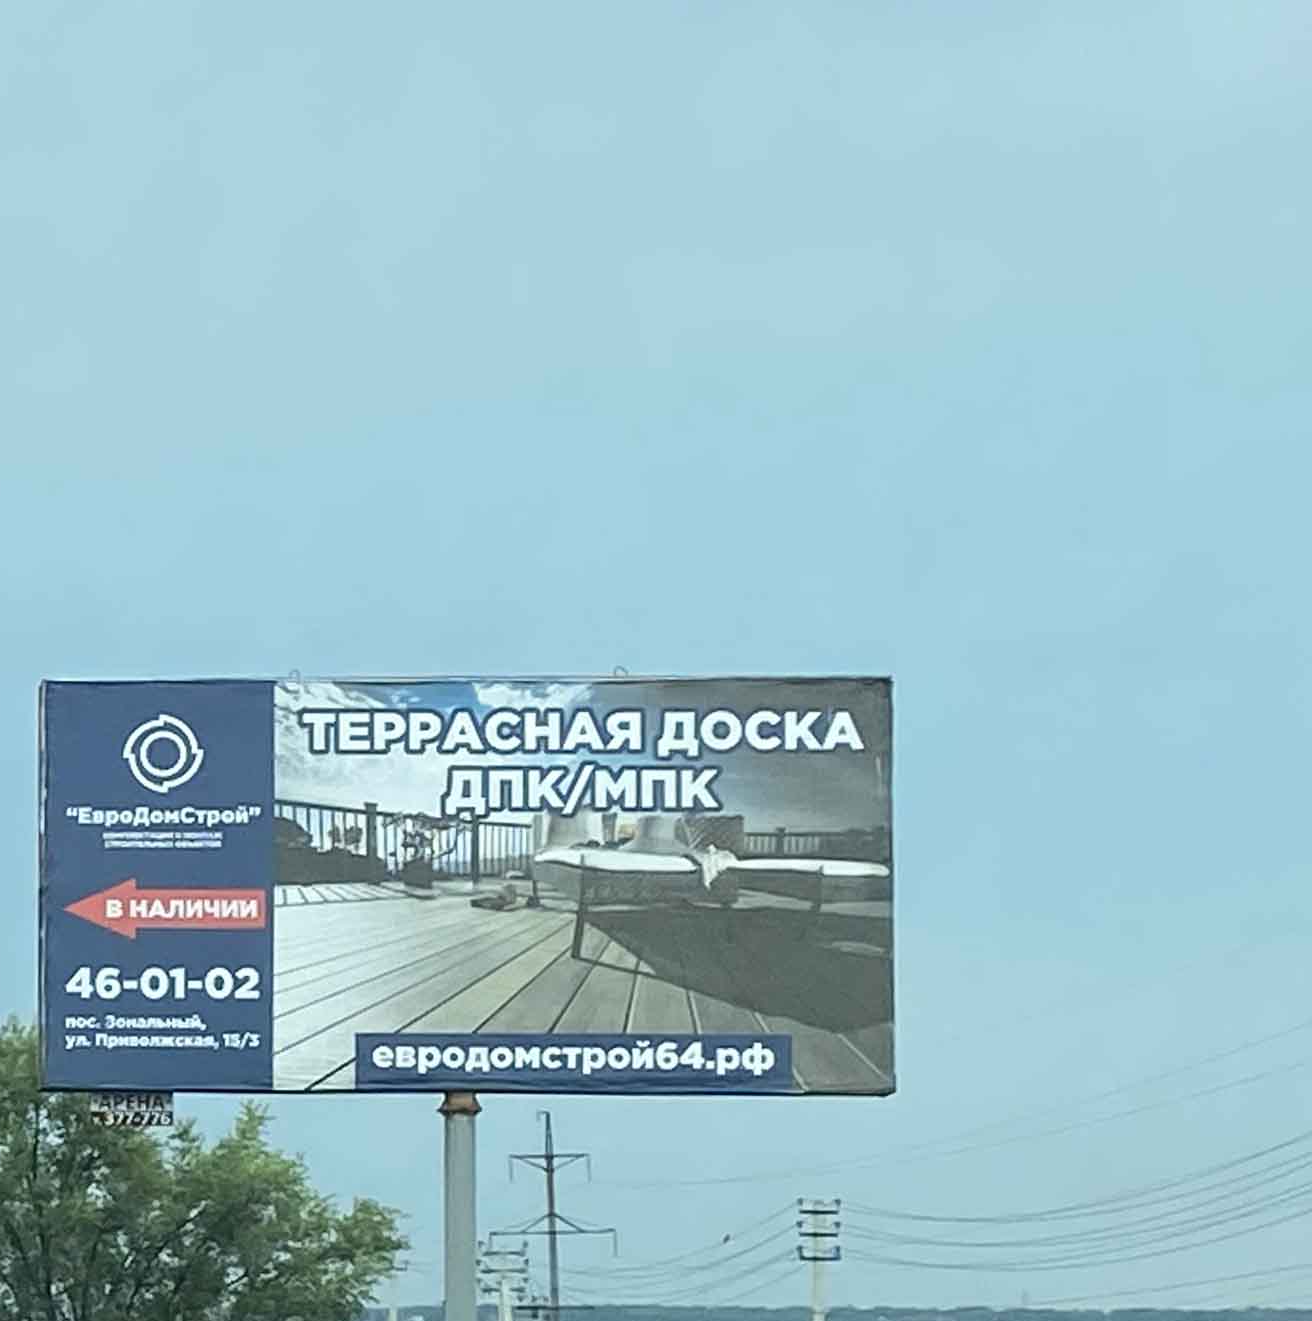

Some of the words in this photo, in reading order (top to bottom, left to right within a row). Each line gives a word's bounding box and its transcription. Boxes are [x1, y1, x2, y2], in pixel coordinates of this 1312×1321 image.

[301, 709, 646, 754] ТЕРРАСНАЯ
[656, 708, 866, 759] ДОСКА
[444, 763, 721, 818] ДПК/МПК
[105, 899, 124, 918] В
[129, 899, 258, 919] НАЛИЧИИ
[65, 966, 261, 1000] 46-01-02
[65, 1016, 101, 1029] пос.
[105, 1014, 207, 1031] Зональный,
[65, 1034, 92, 1049] ул.
[95, 1033, 220, 1049] Приволжская,
[372, 1040, 775, 1075] евродомстрой64.рф
